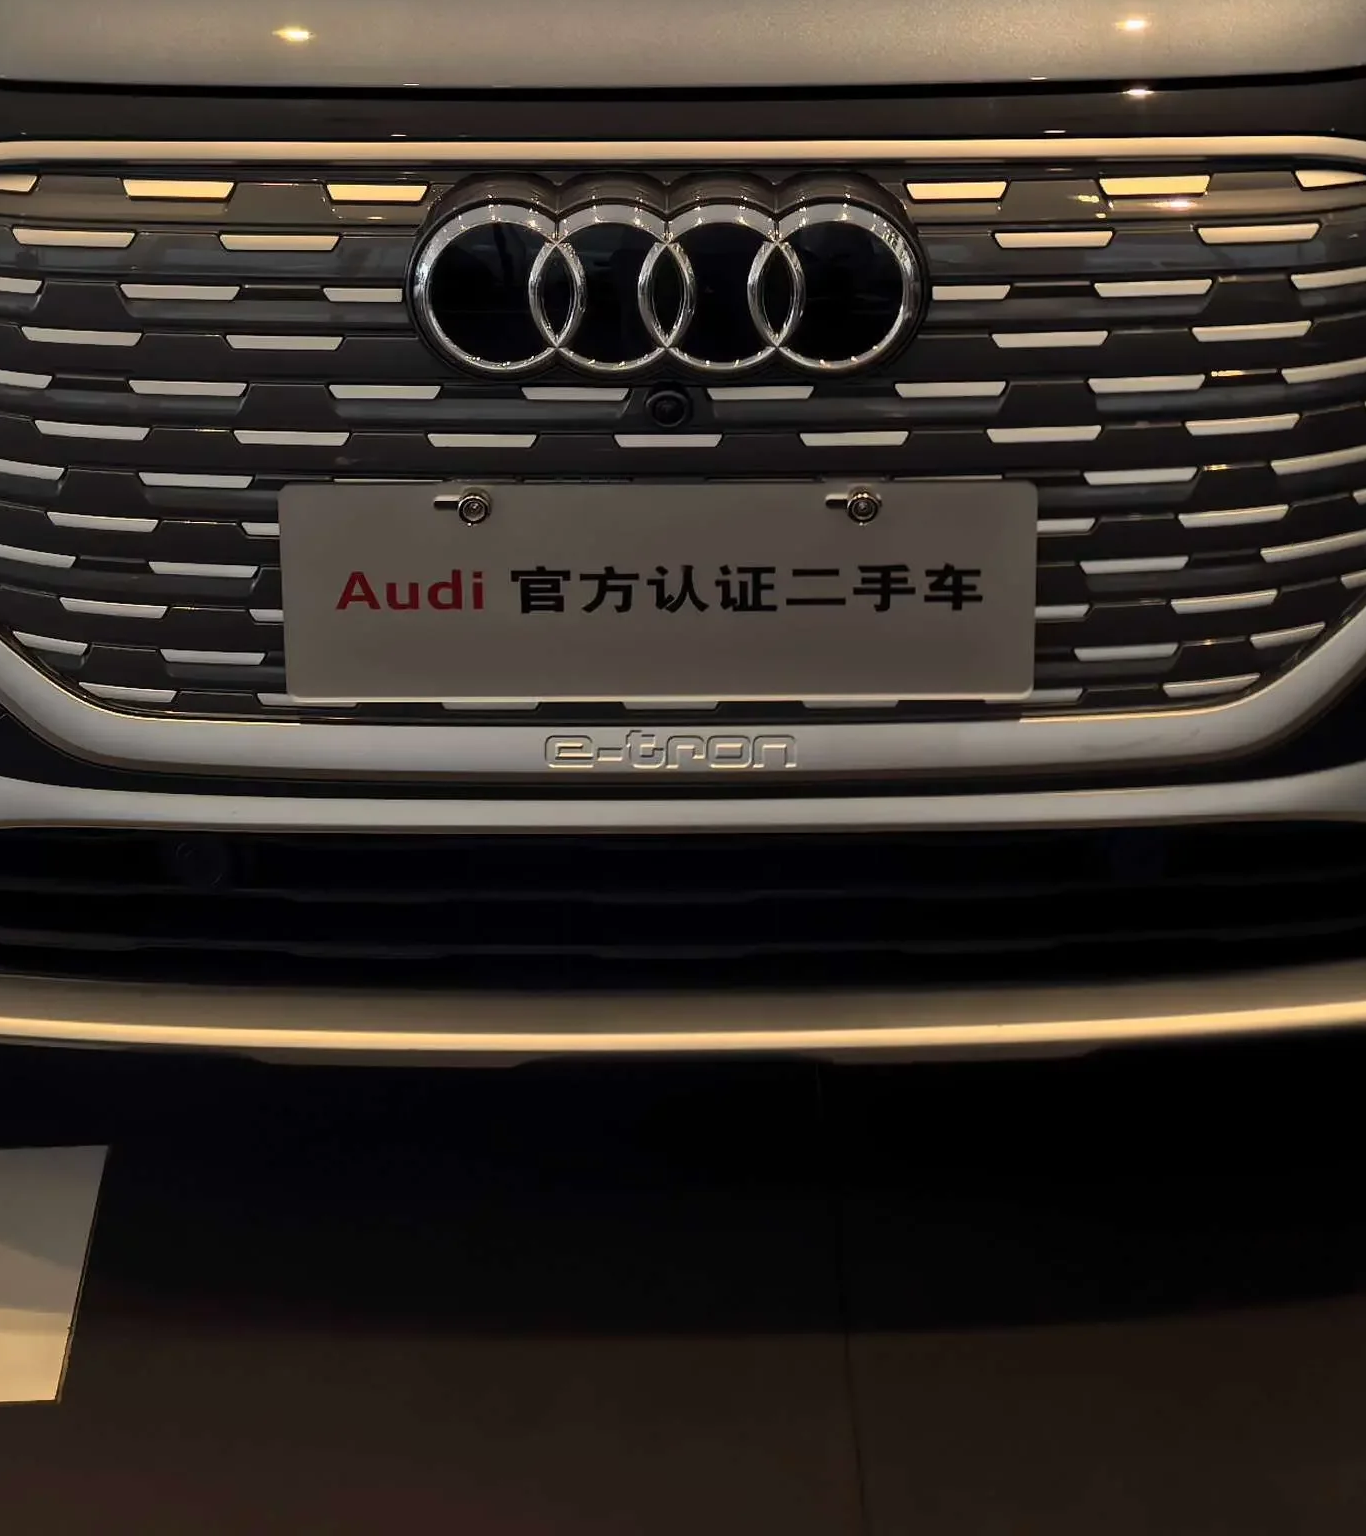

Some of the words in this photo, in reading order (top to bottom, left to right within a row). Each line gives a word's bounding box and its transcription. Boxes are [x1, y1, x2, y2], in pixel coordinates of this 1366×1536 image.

[336, 569, 484, 611] Audi
[510, 563, 983, 613] 官方认证二手车
[545, 729, 797, 769] e-tron
